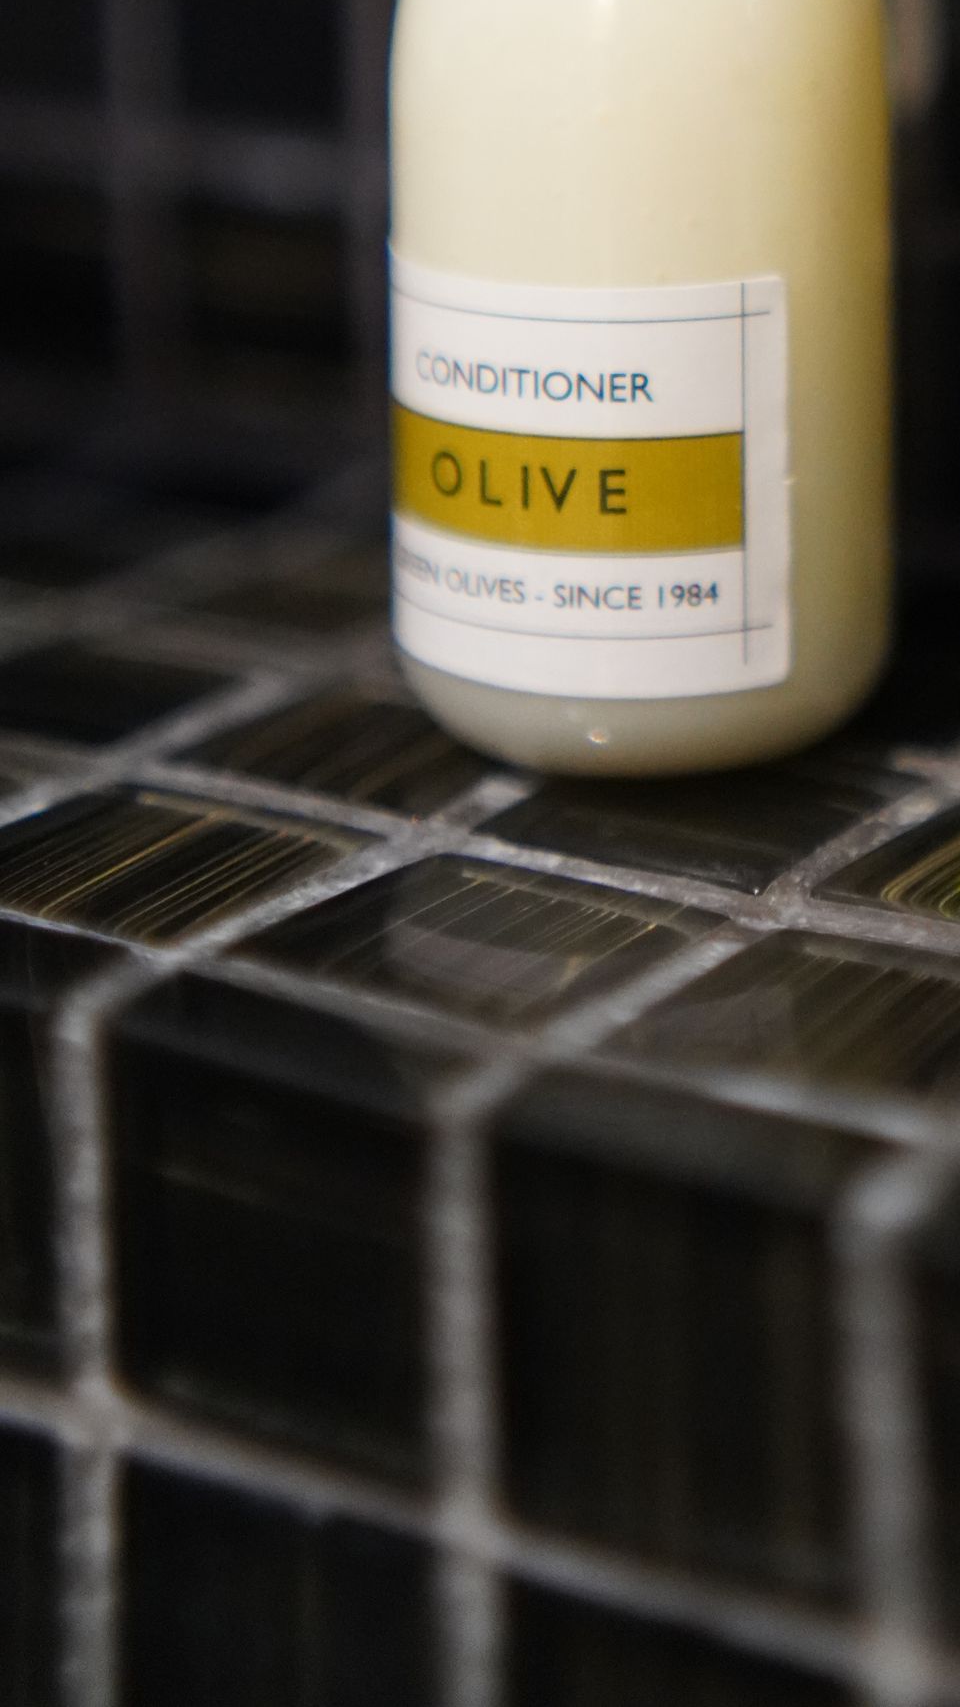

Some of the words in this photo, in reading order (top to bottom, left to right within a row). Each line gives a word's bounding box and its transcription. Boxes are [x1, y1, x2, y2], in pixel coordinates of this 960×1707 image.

[416, 349, 655, 404] CONDITIONER
[432, 451, 628, 515] OLIVE
[446, 567, 526, 605] OLIVES
[553, 585, 642, 610] SINCE
[658, 582, 720, 608] 1984
